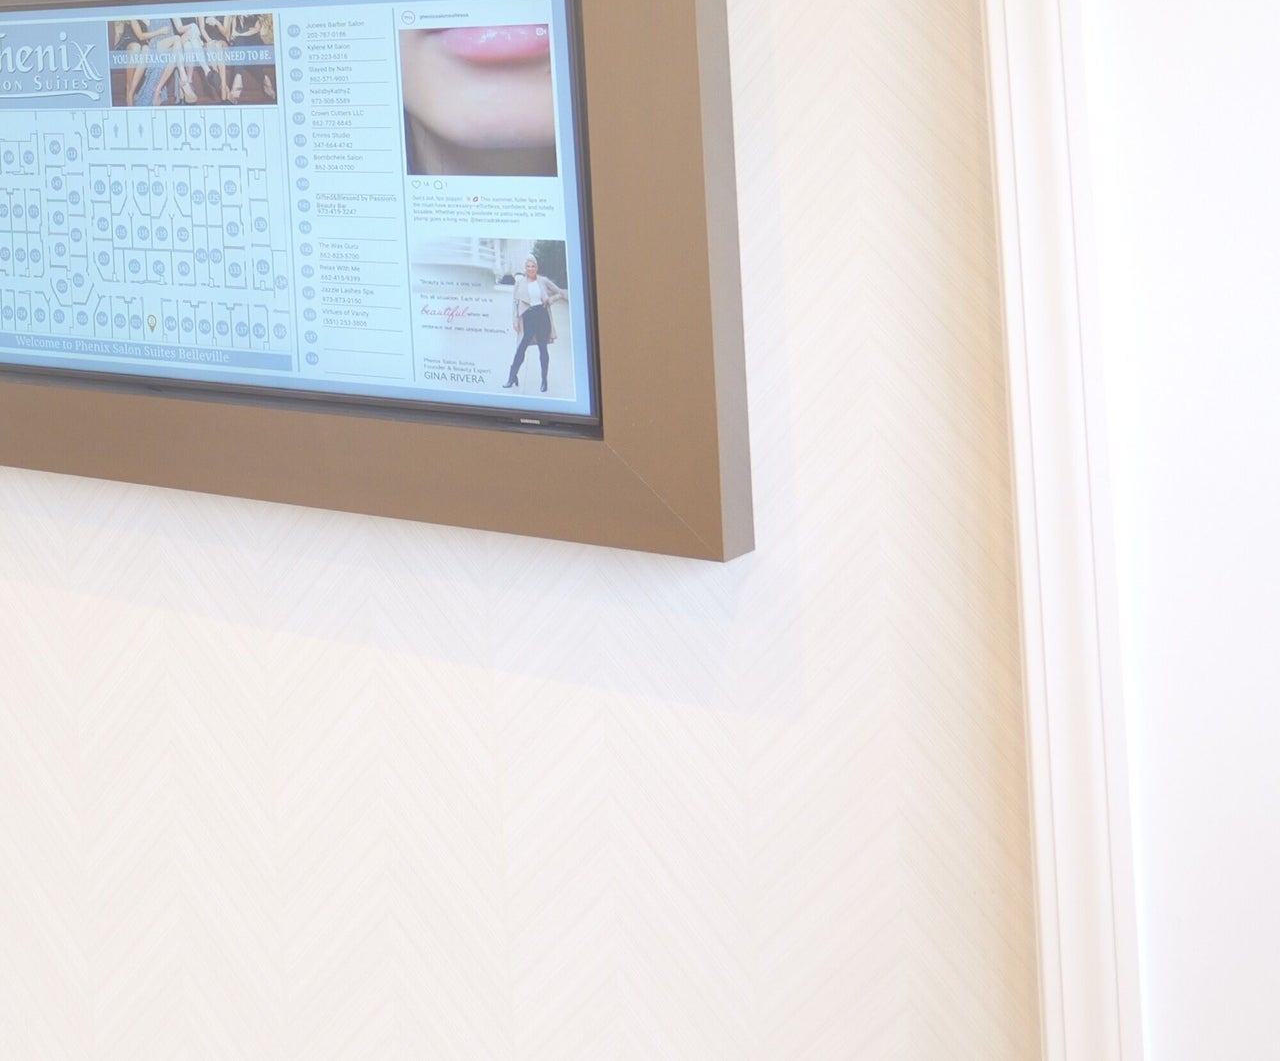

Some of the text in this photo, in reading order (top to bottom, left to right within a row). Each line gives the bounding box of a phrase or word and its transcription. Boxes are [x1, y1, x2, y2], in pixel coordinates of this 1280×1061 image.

[112, 53, 128, 64] YOU
[207, 51, 224, 62] YOU
[225, 50, 245, 61] NEED
[247, 50, 258, 60] TO
[260, 50, 272, 60] BE.
[421, 304, 469, 323] beautiful
[16, 336, 230, 363] Welcome to Phenix Salon Suites Belleville
[424, 371, 486, 384] GINA RIVERA
